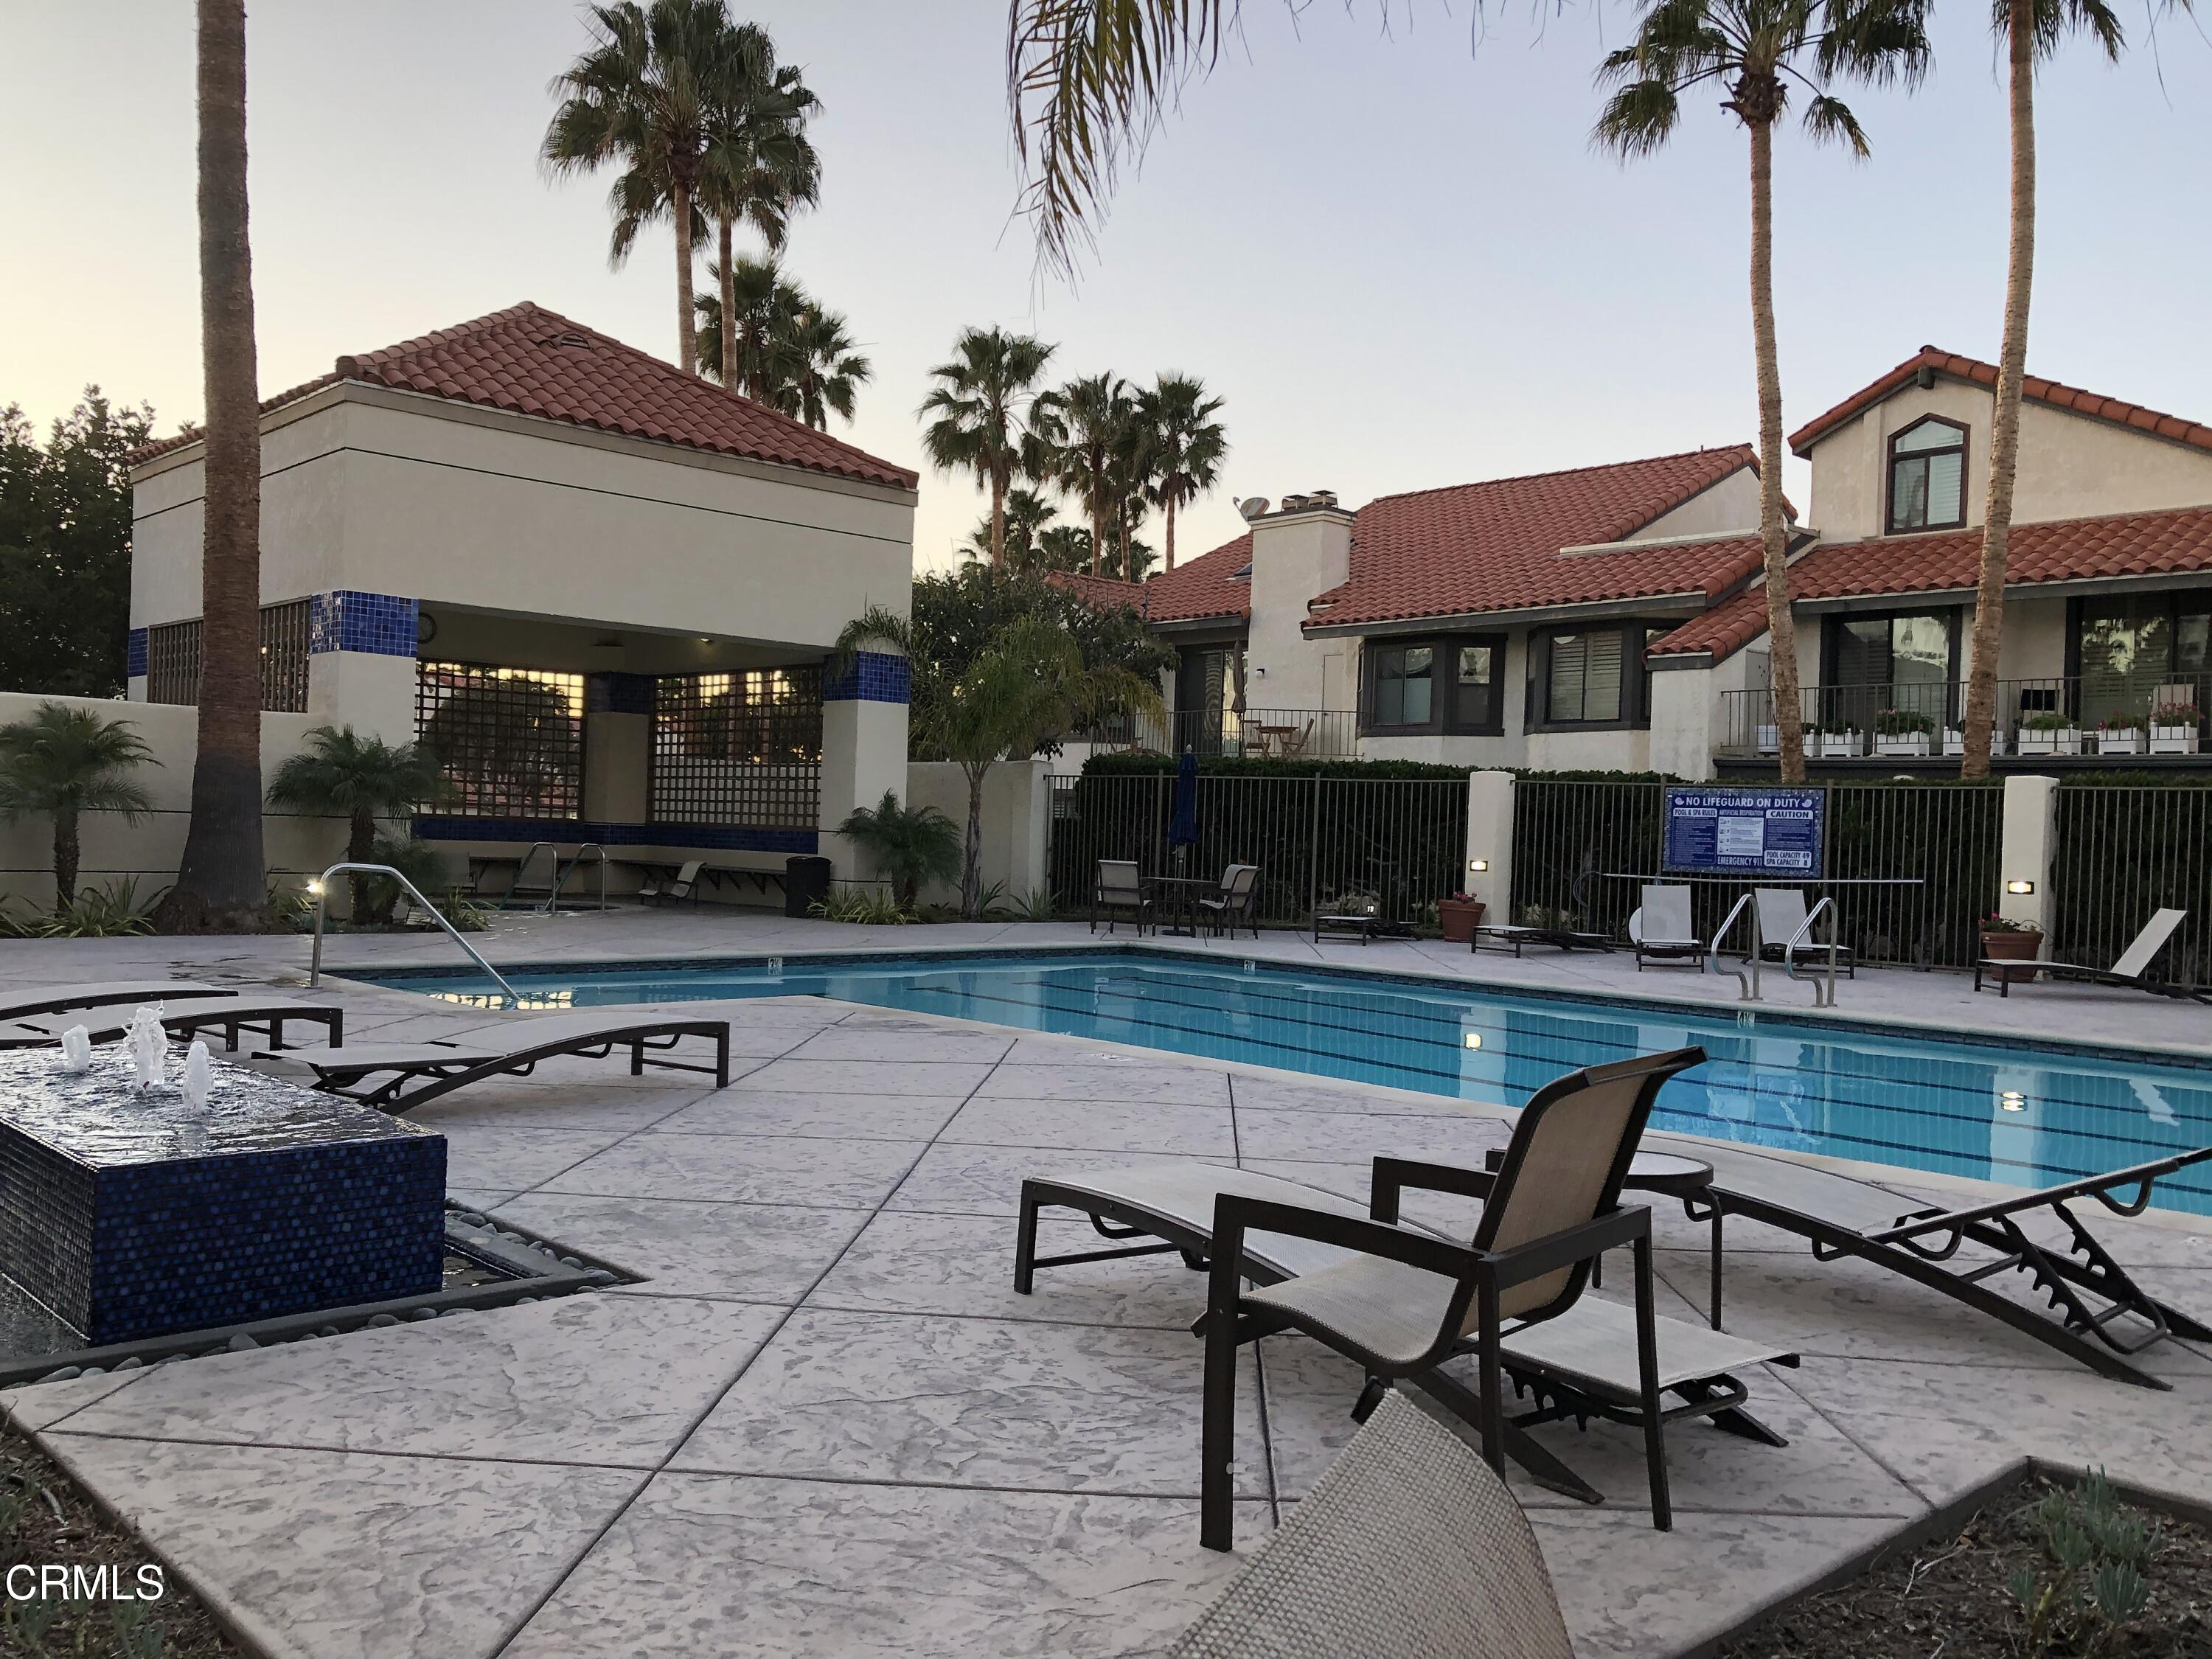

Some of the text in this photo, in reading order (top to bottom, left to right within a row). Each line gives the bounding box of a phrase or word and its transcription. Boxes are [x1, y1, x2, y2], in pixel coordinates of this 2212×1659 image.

[1686, 797, 1800, 807] NO LIFEGUARD ON DUTY
[1717, 856, 1762, 866] EMERGENCY 911
